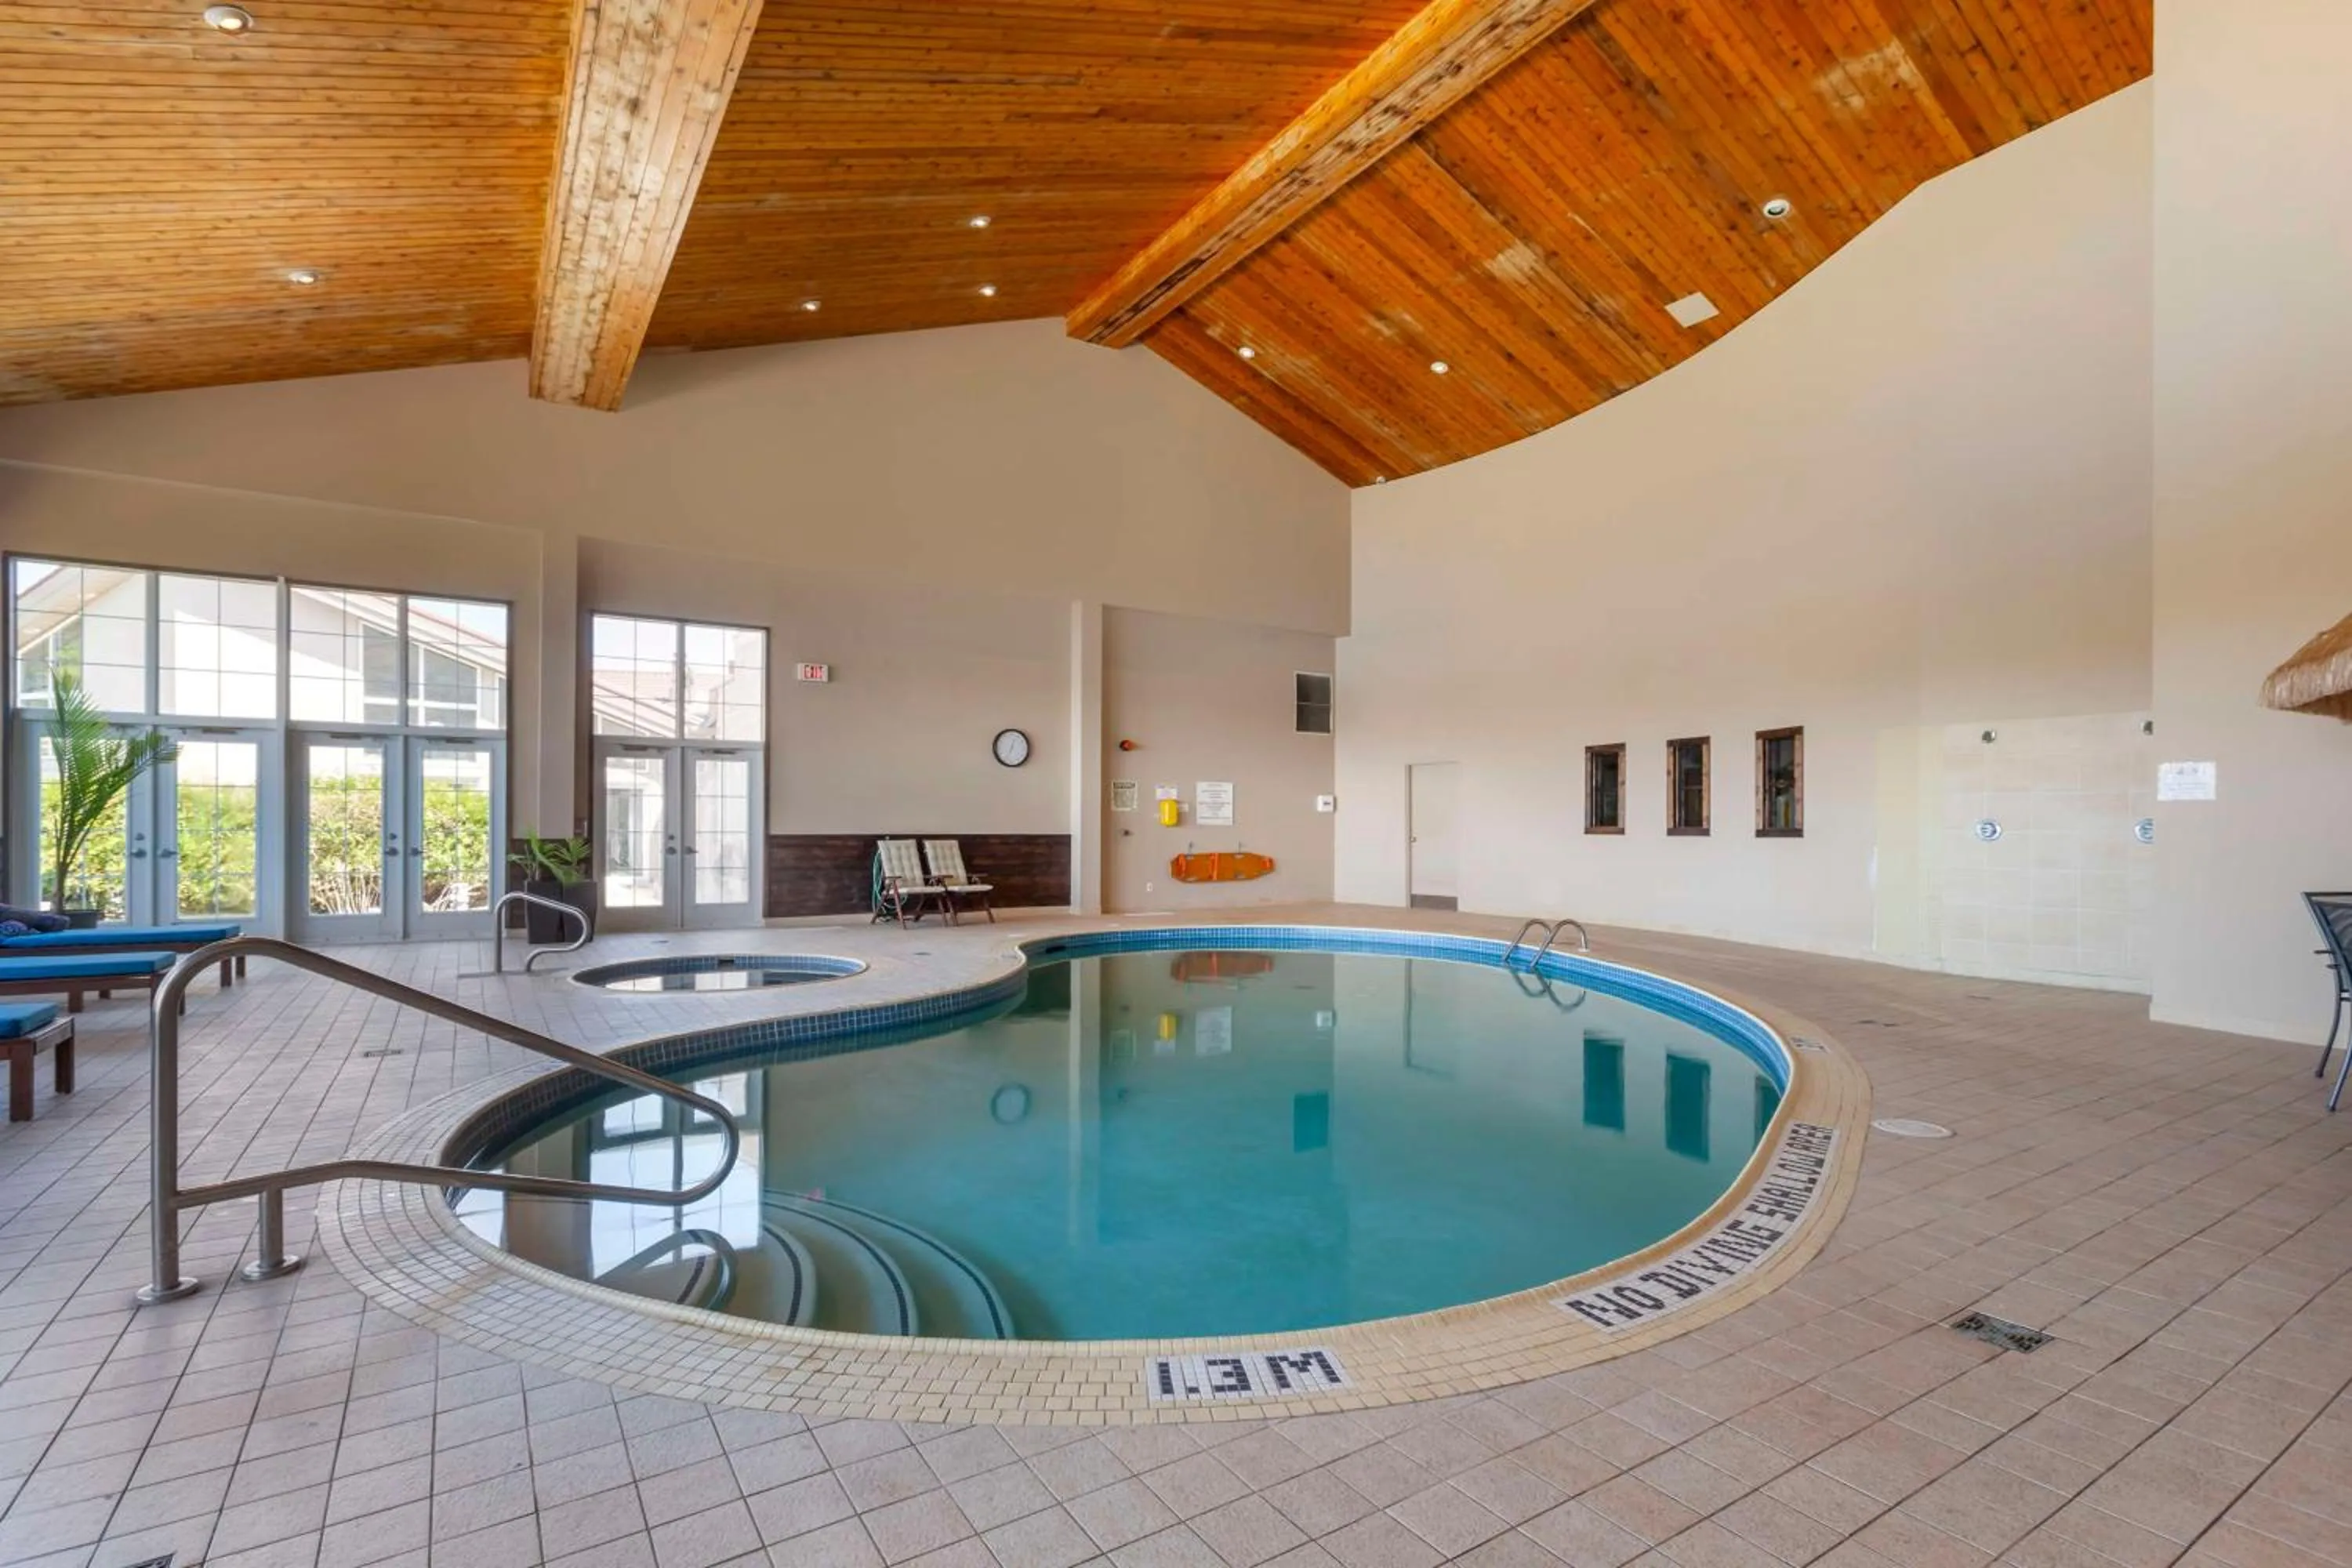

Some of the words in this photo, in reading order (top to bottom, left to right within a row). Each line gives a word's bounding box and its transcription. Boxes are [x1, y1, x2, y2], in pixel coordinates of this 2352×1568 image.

[1566, 1287, 1664, 1327] NO
[1639, 1219, 1784, 1299] DIVING
[1744, 1150, 1825, 1222] SHALLOW
[1785, 1123, 1833, 1155] AREA
[1266, 1351, 1341, 1388] M
